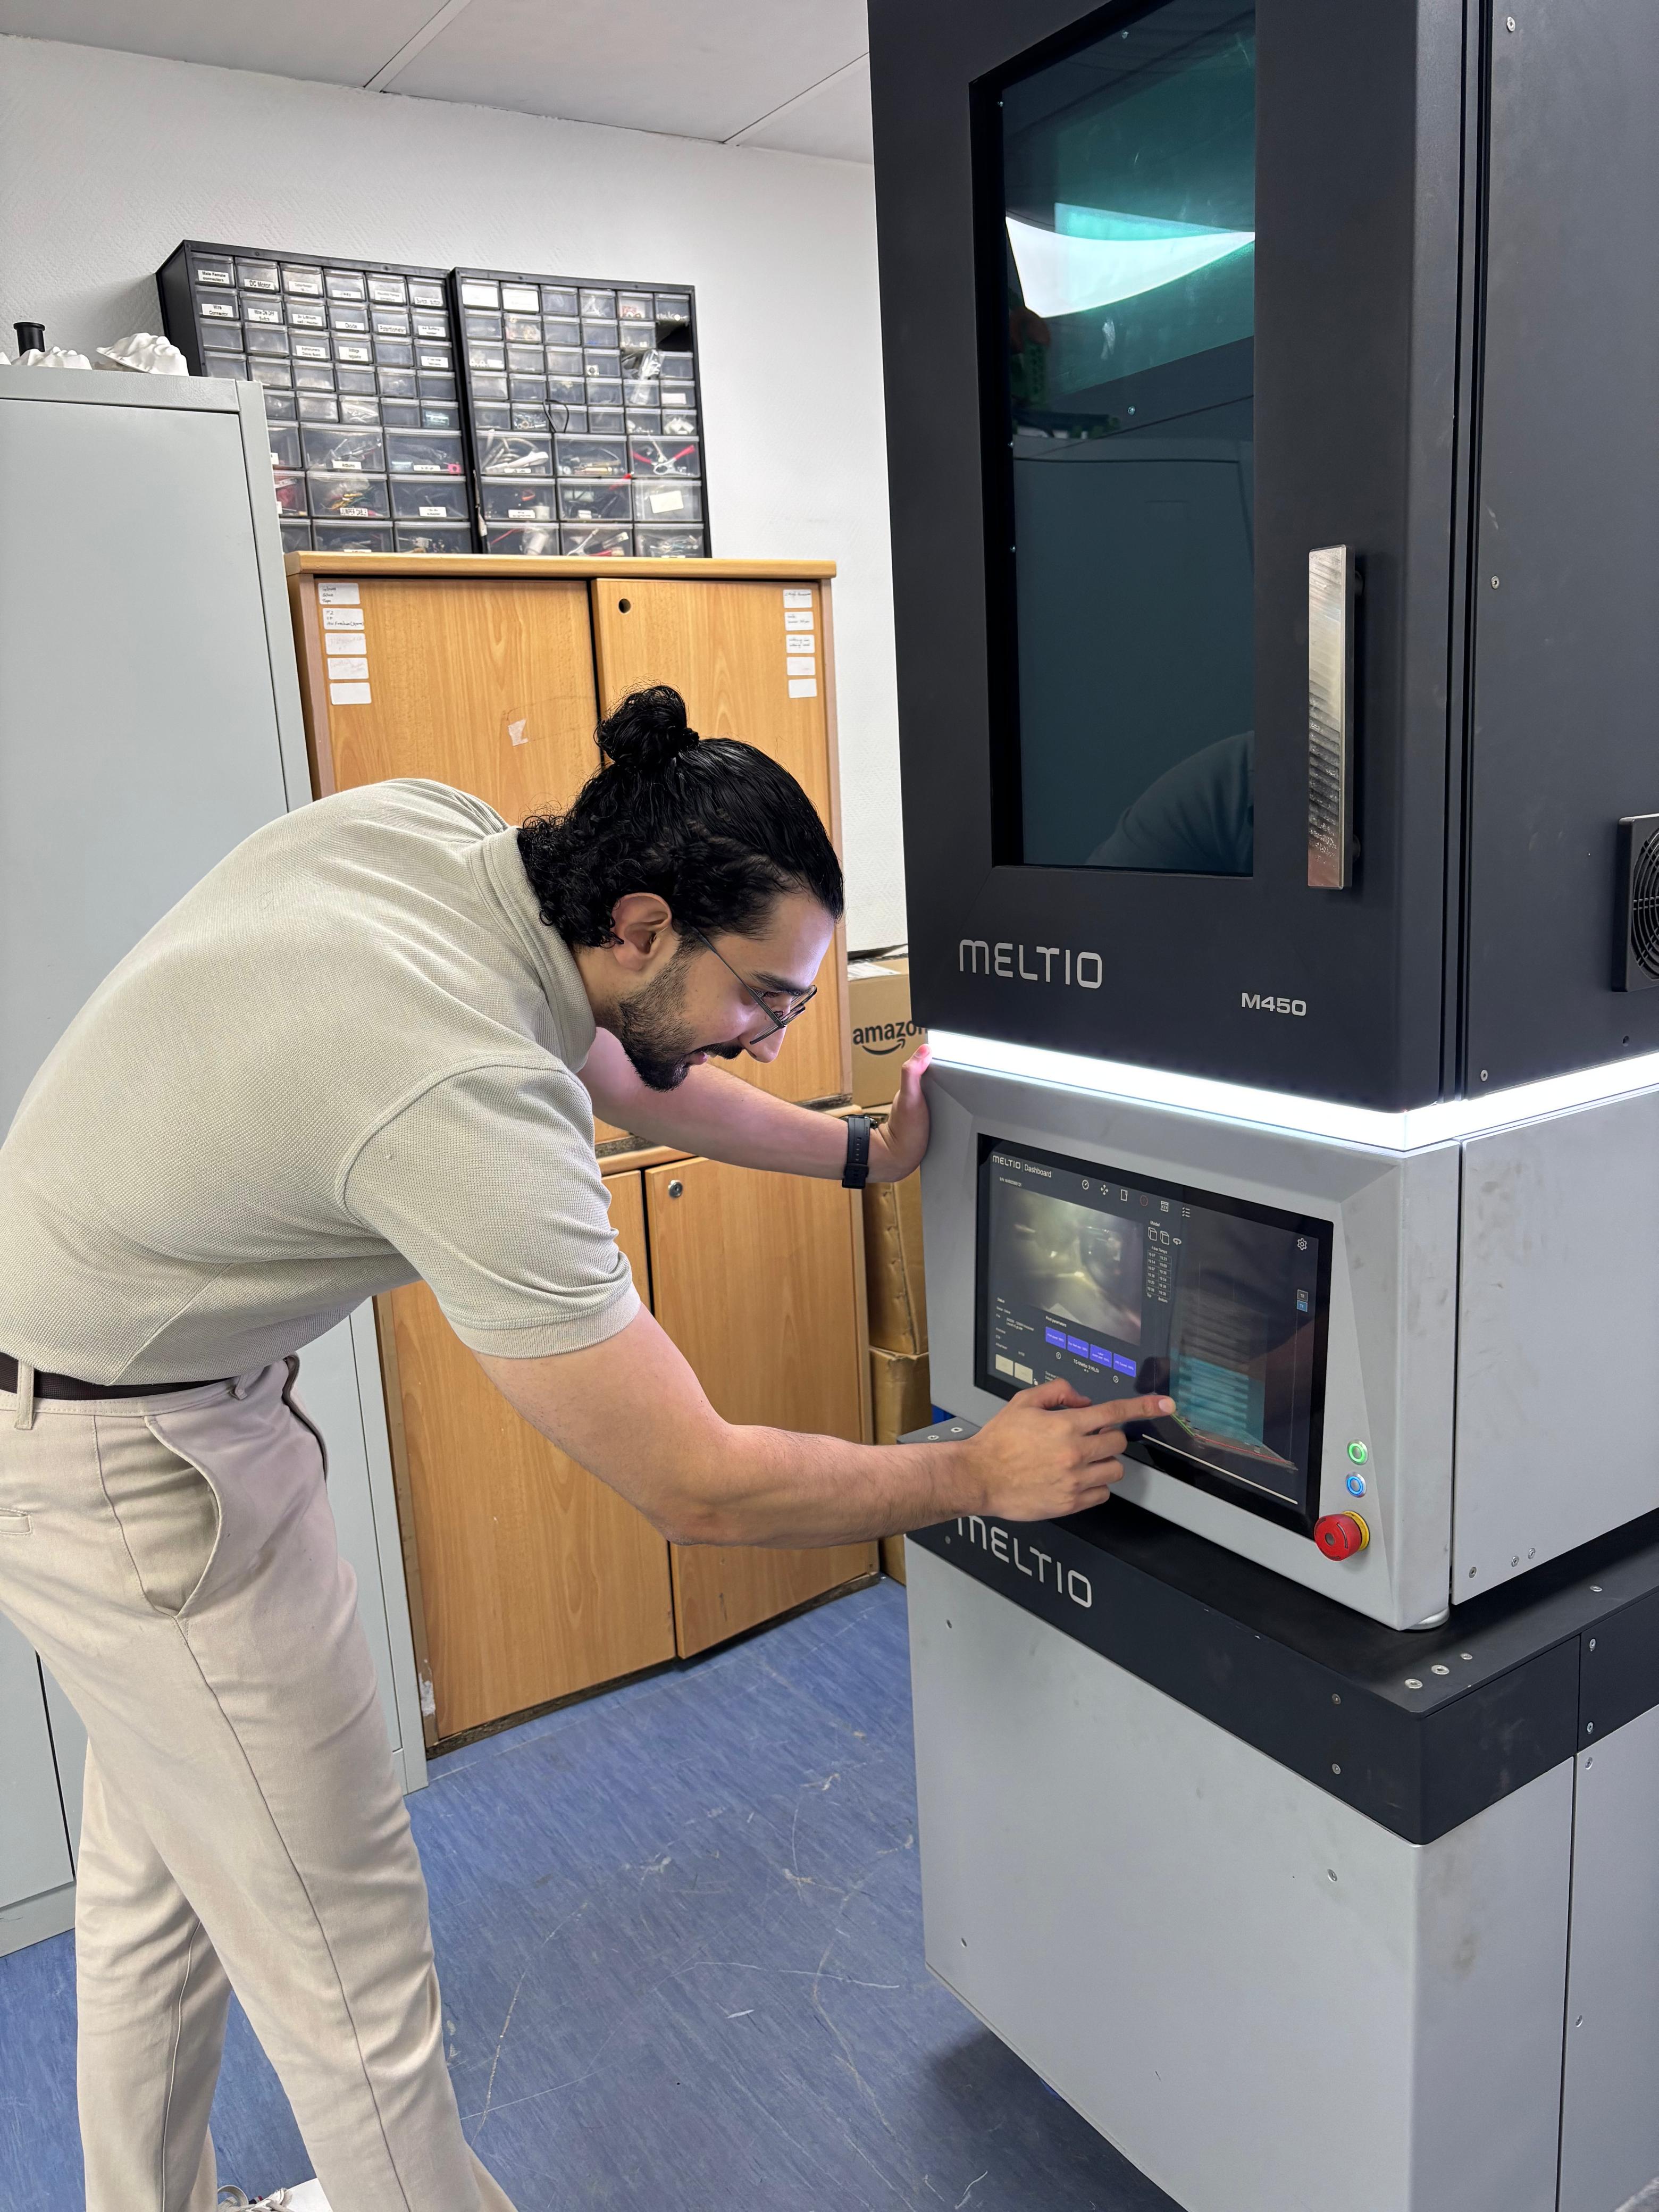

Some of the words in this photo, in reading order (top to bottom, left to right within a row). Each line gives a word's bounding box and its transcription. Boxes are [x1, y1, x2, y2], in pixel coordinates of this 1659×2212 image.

[959, 939, 1103, 989] MELTIO
[1242, 992, 1306, 1016] M450
[992, 1155, 1020, 1169] MELTIO
[1024, 1164, 1052, 1178] Dashboard
[958, 1515, 1092, 1607] MELTIO
